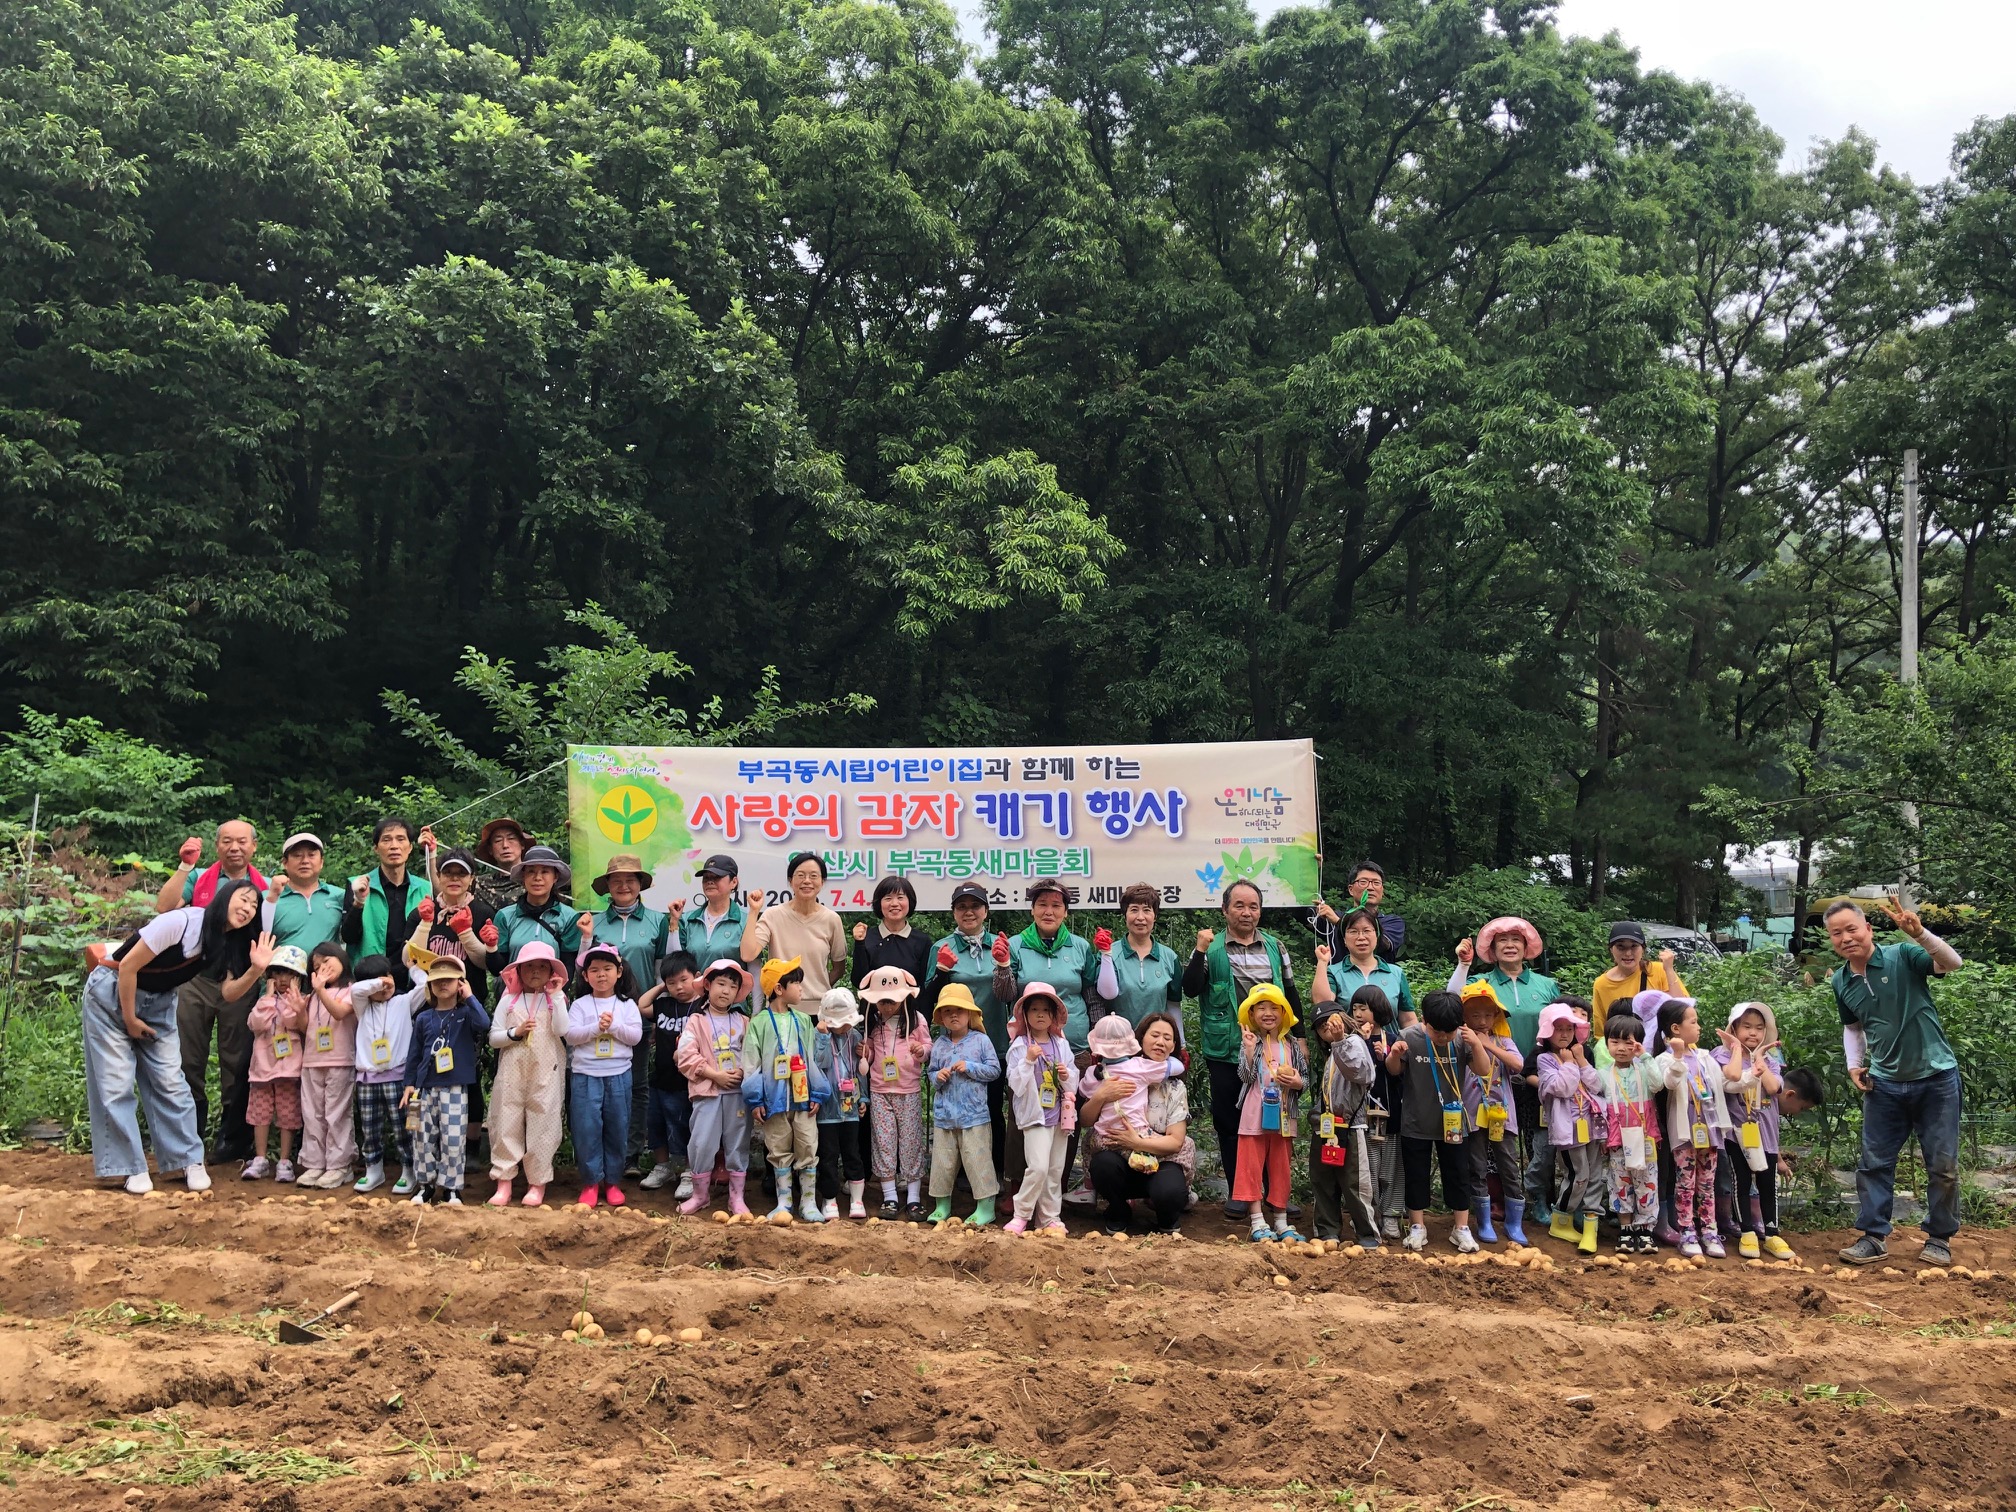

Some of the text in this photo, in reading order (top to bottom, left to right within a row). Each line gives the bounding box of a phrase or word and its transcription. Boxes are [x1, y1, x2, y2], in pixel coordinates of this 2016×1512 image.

[738, 757, 1140, 783] 부곡동시립어린이집과 함께 하는
[690, 790, 1184, 838] 사랑의 감자 캐기 행사
[1214, 786, 1292, 817] 온기나눔
[1245, 818, 1281, 831] 대한민국
[788, 847, 1090, 879] 산시 부곡동새마을회
[830, 889, 846, 907] 7.
[1087, 885, 1182, 906] 새마장
